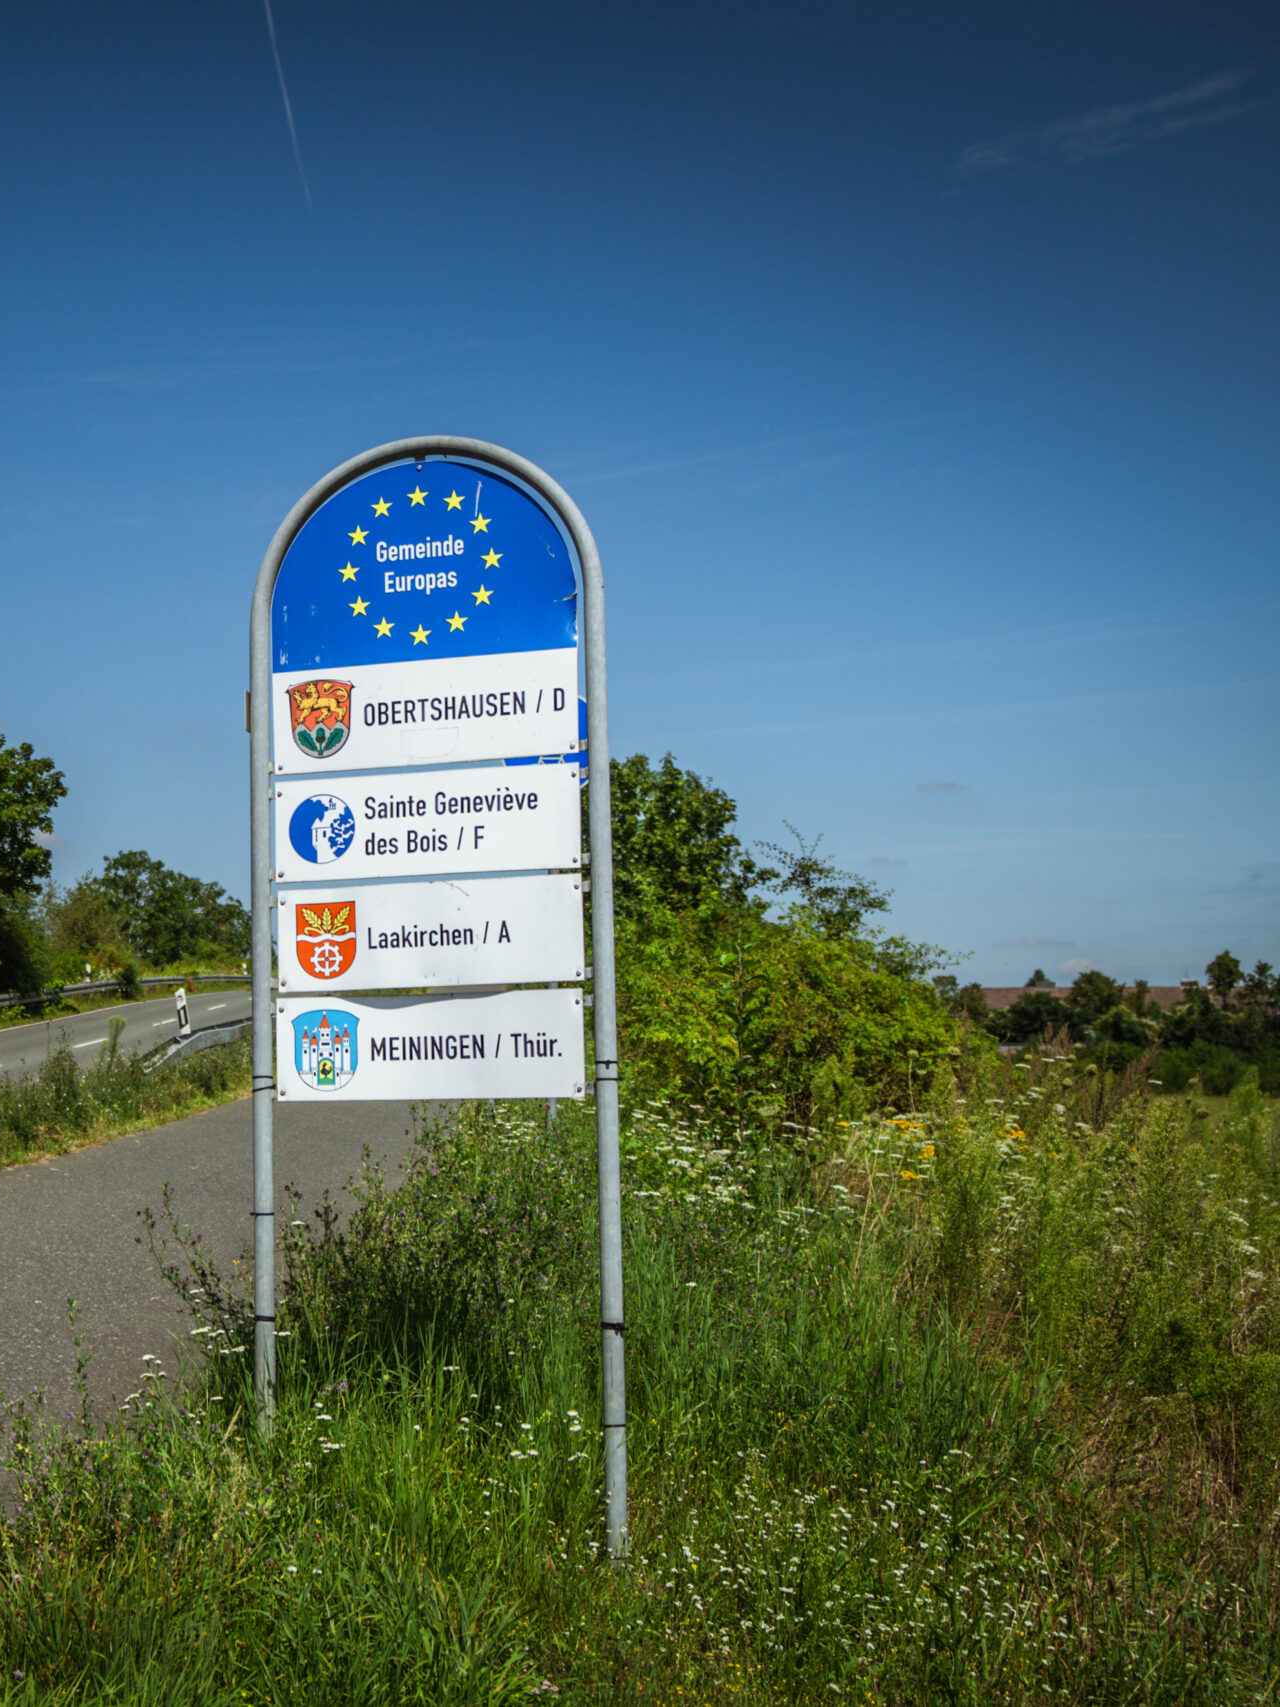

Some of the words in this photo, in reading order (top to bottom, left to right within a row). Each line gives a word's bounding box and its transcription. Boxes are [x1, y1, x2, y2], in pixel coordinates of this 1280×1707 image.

[376, 534, 464, 563] Gemeinde
[384, 571, 457, 595] Europas
[364, 691, 525, 726] OBERTSHAUSEN
[535, 689, 543, 713] /
[553, 687, 565, 711] D
[365, 795, 426, 820] Sainte
[434, 787, 539, 816] Geneviève
[365, 832, 398, 856] des
[407, 828, 448, 853] Bois
[456, 826, 464, 851] /
[474, 825, 485, 850] F
[368, 924, 474, 950] Laakirchen
[482, 921, 490, 945] /
[498, 920, 511, 943] A
[371, 1034, 485, 1062] MEININGEN
[494, 1033, 502, 1059] /
[510, 1031, 563, 1058] Thür.
